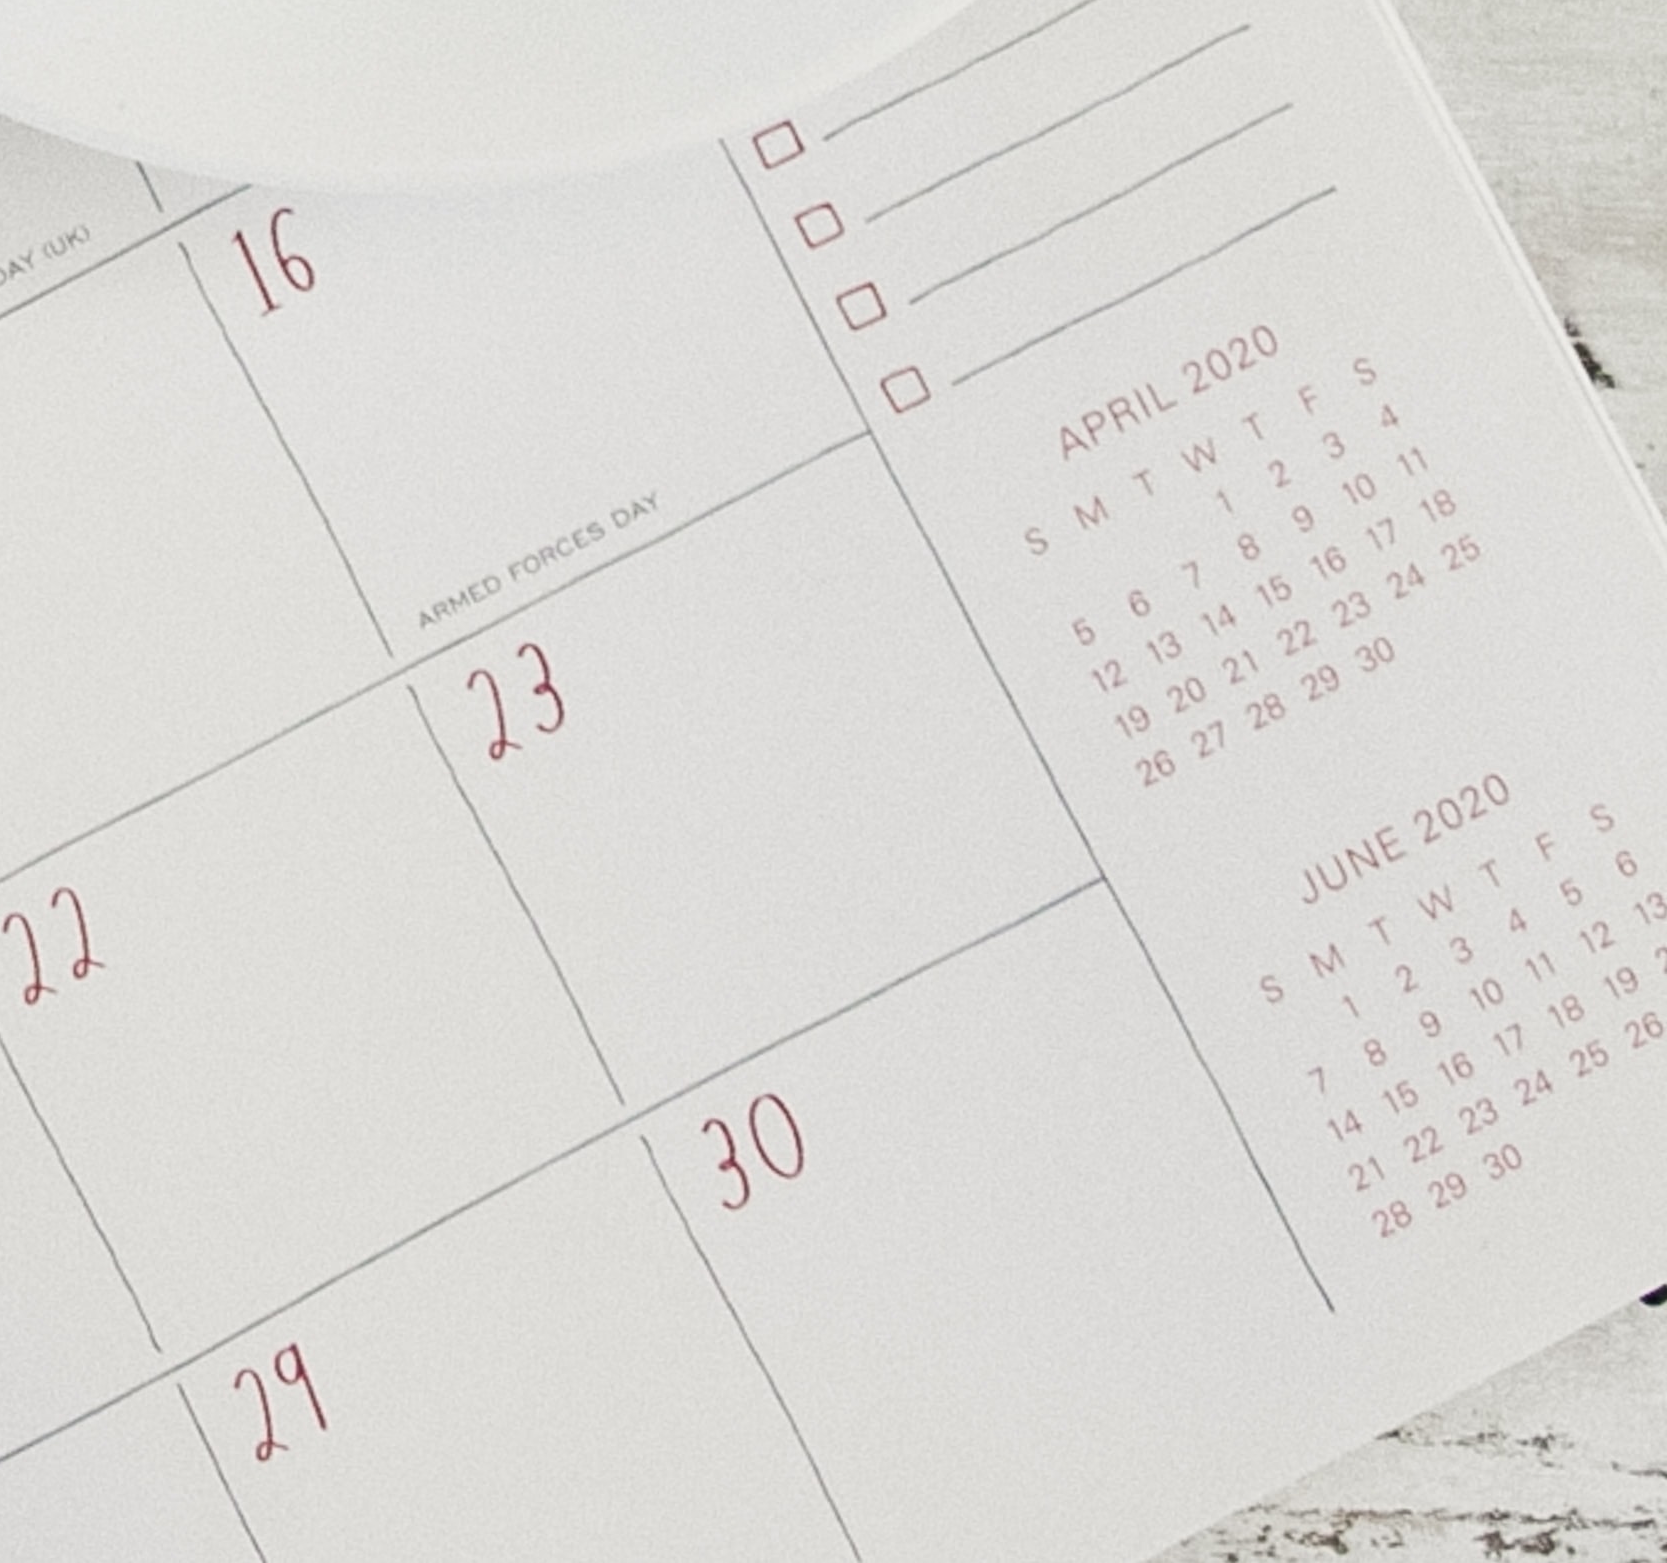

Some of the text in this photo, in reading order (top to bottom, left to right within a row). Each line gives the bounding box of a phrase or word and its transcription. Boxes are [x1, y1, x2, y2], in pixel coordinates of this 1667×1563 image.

[44, 224, 90, 260] (UK)
[232, 206, 316, 317] 16
[1024, 357, 1377, 556] S M T W T F S
[1056, 324, 1280, 461] APRIL 2020
[1216, 404, 1399, 513] 1 2 3 4
[418, 491, 659, 630] ARMED FORCES DAY
[1072, 447, 1428, 646] 5 6 7 8 9 10 11
[1090, 489, 1457, 692] 12 13 14 15 16 17 18
[466, 642, 566, 762] 23
[1115, 534, 1481, 738] 19 20 21 22 23 24 25
[1135, 636, 1395, 788] 26 27 28 29 30
[1259, 803, 1615, 1005] S M T W T F S
[1301, 772, 1510, 906] JUNE 2020
[1, 887, 105, 1006] 22
[1342, 850, 1638, 1018] 1 2 3 4 5 6
[1307, 1066, 1326, 1094] 7
[1363, 1038, 1388, 1067] 8
[1419, 1011, 1442, 1038] 9
[1469, 977, 1504, 1010] 10
[1525, 951, 1556, 982] 11
[1579, 920, 1616, 953] 12
[1327, 966, 1639, 1142] 14 15 16 17 18 19
[701, 1092, 805, 1211] 30
[1348, 1011, 1665, 1192] 21 22 23 24 25 26
[1371, 1143, 1523, 1239] 28 29 30
[233, 1342, 328, 1463] 29
